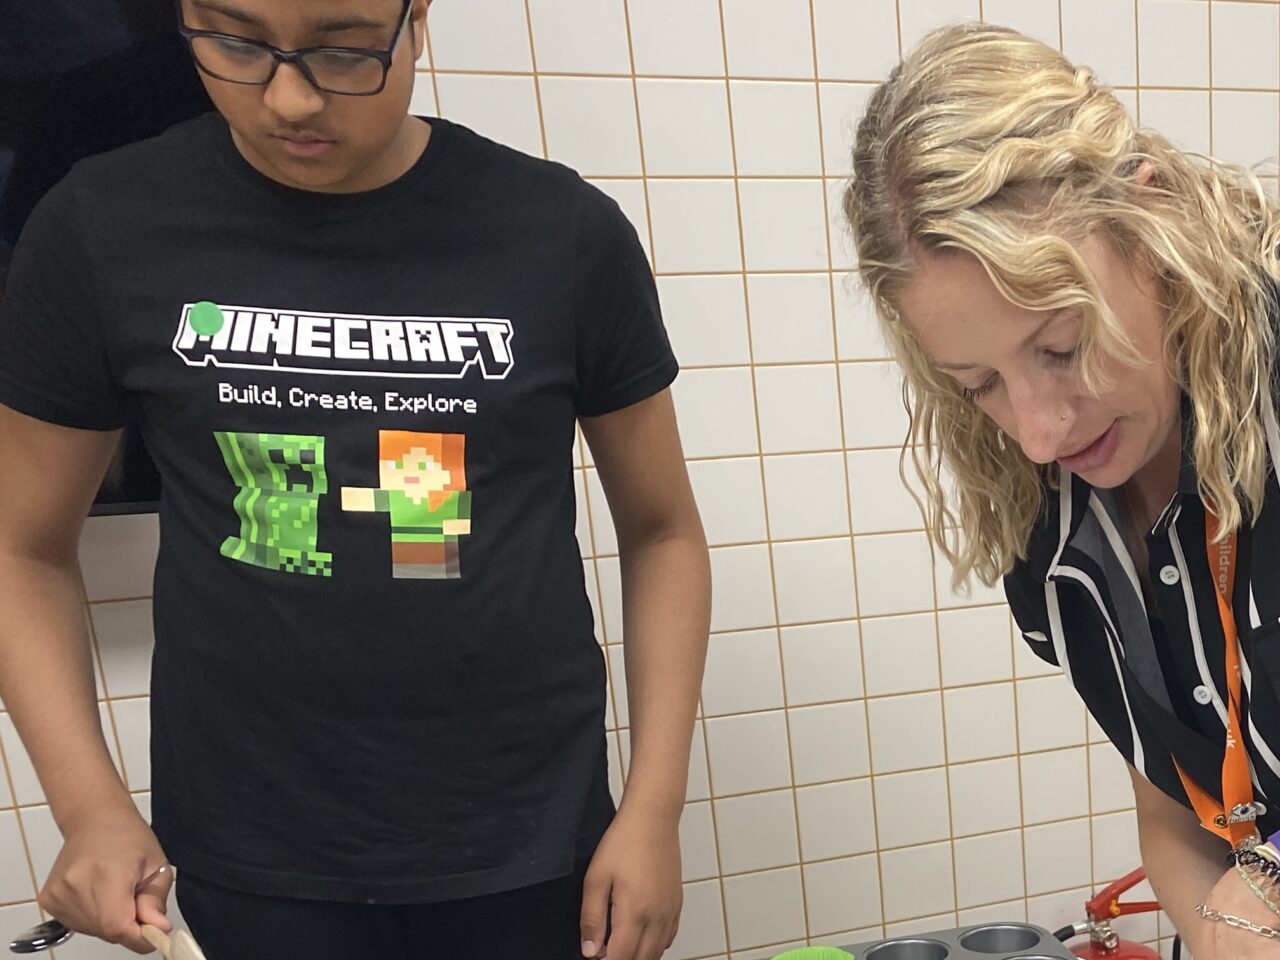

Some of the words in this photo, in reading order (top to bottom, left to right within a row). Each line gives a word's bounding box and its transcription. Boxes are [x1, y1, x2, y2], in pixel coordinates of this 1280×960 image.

[175, 304, 512, 370] MINECRAFT
[218, 383, 282, 408] Build,
[289, 387, 378, 413] Create,
[385, 392, 478, 414] Explore
[1218, 536, 1231, 594] hildren
